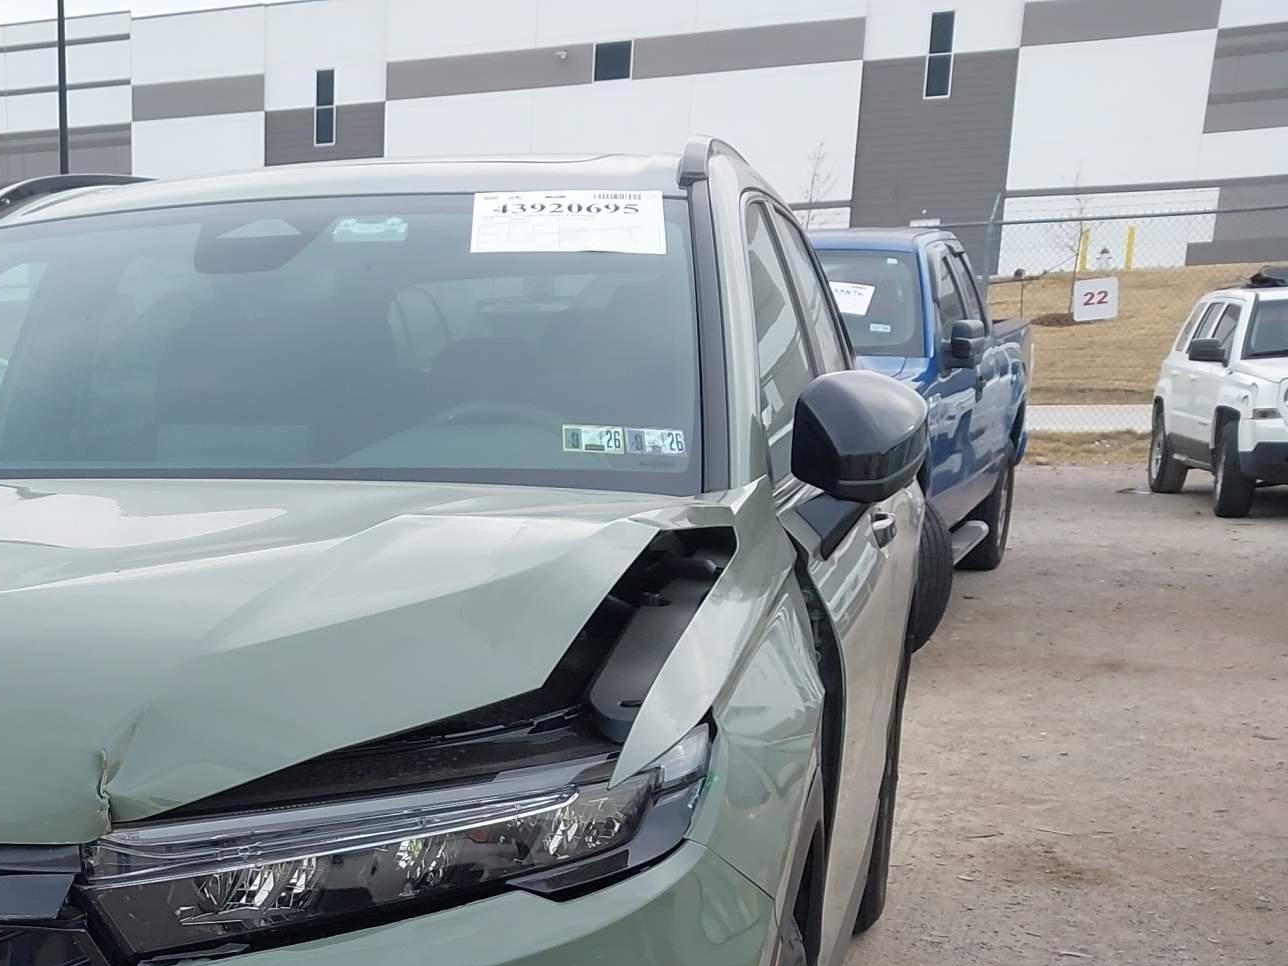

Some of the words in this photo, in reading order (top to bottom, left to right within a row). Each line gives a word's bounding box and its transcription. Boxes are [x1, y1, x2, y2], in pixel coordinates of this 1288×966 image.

[493, 203, 640, 215] 43920695
[1083, 290, 1109, 306] 22
[605, 430, 621, 449] 26
[667, 432, 684, 452] 26
